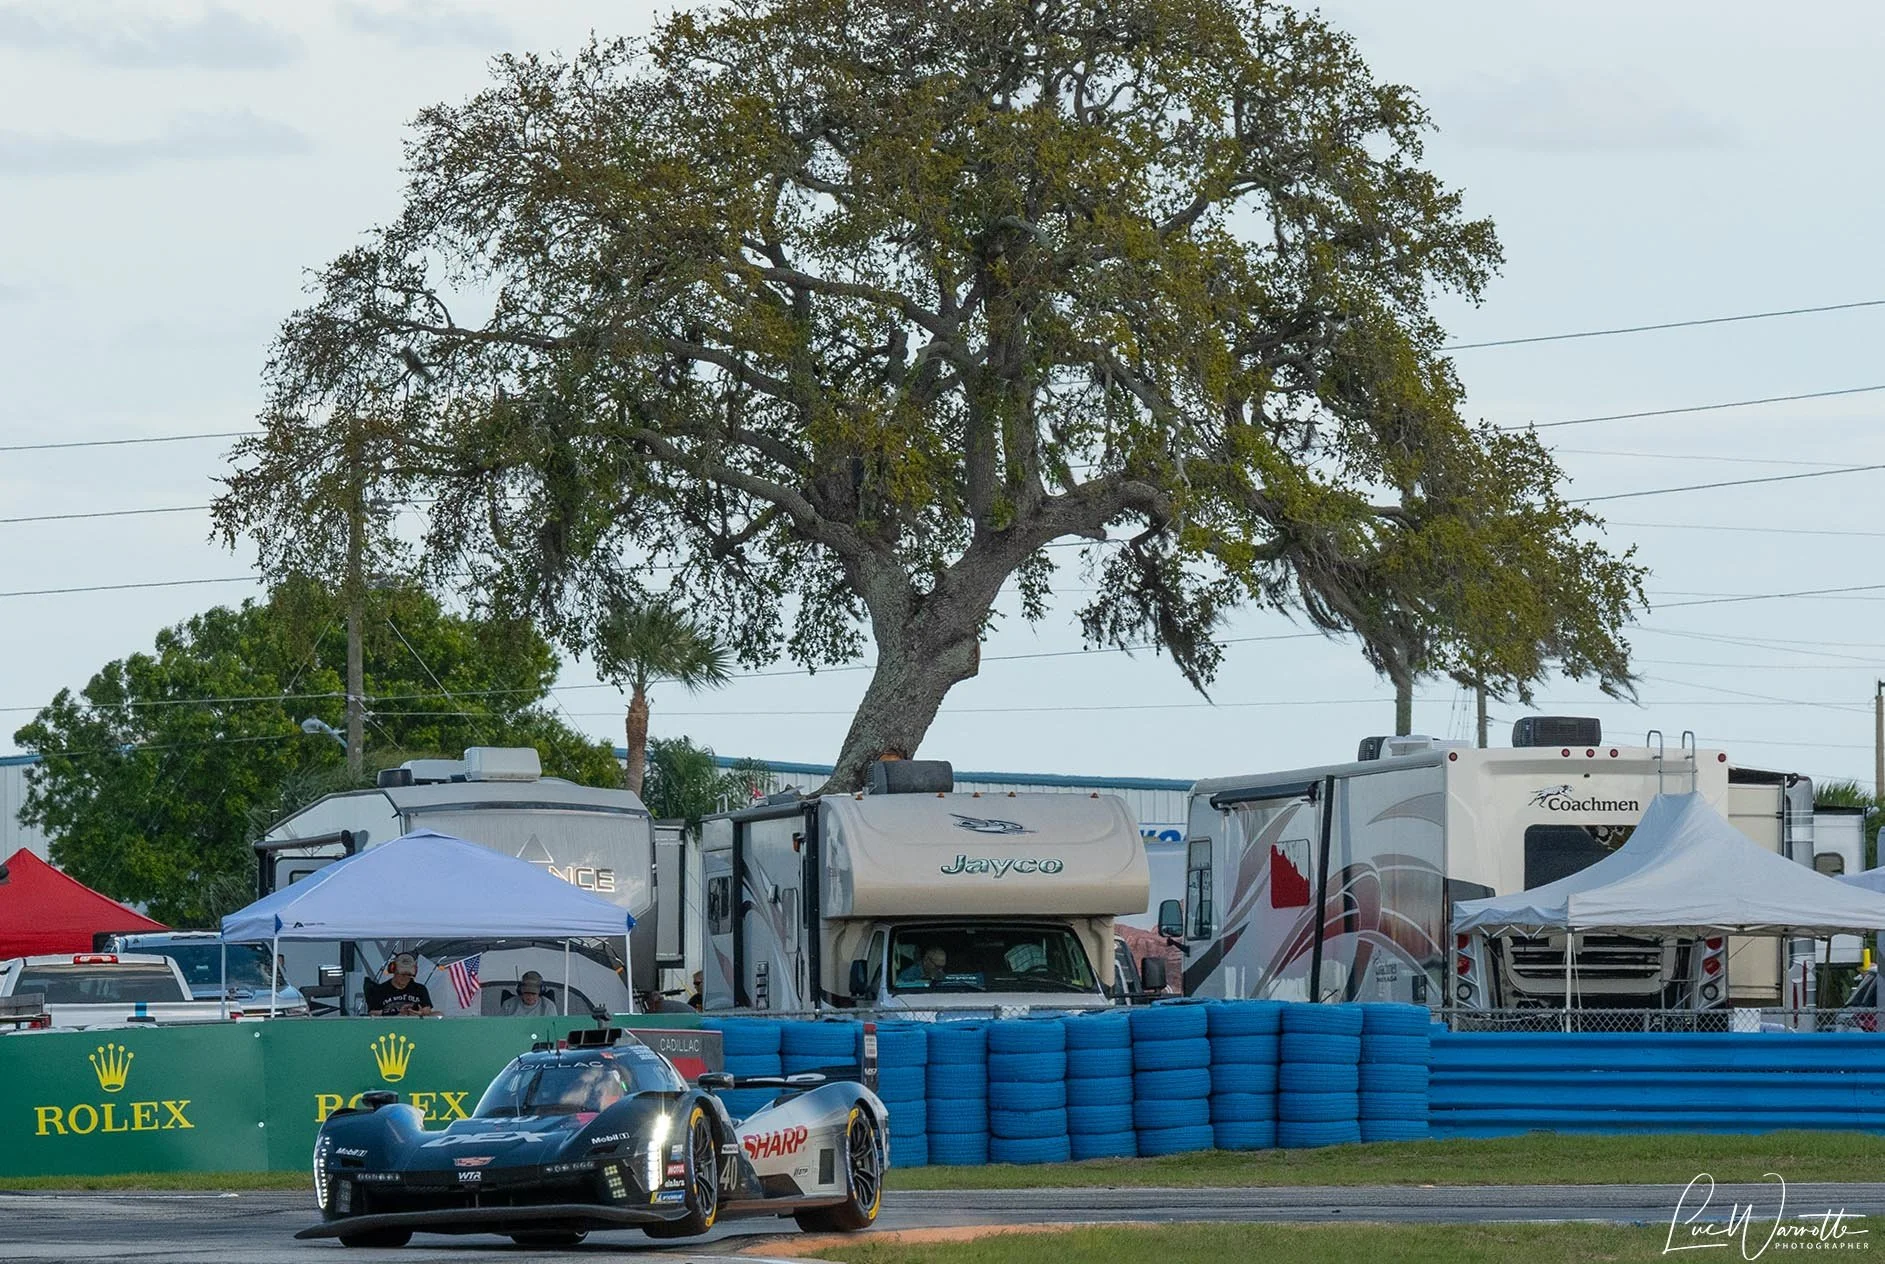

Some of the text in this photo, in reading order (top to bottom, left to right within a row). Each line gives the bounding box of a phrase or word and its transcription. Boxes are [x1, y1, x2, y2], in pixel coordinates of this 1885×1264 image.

[1548, 797, 1639, 812] Coachmen
[940, 854, 1064, 879] Jayco
[659, 1038, 700, 1052] CADILLAC
[510, 1061, 604, 1071] ADILLAC
[314, 1092, 470, 1122] REX
[34, 1100, 195, 1136] ROLEX
[591, 1133, 619, 1144] Mobil
[743, 1125, 808, 1160] SHARP
[335, 1147, 358, 1156] Mobil
[458, 1171, 482, 1180] WTR
[719, 1155, 738, 1191] 40
